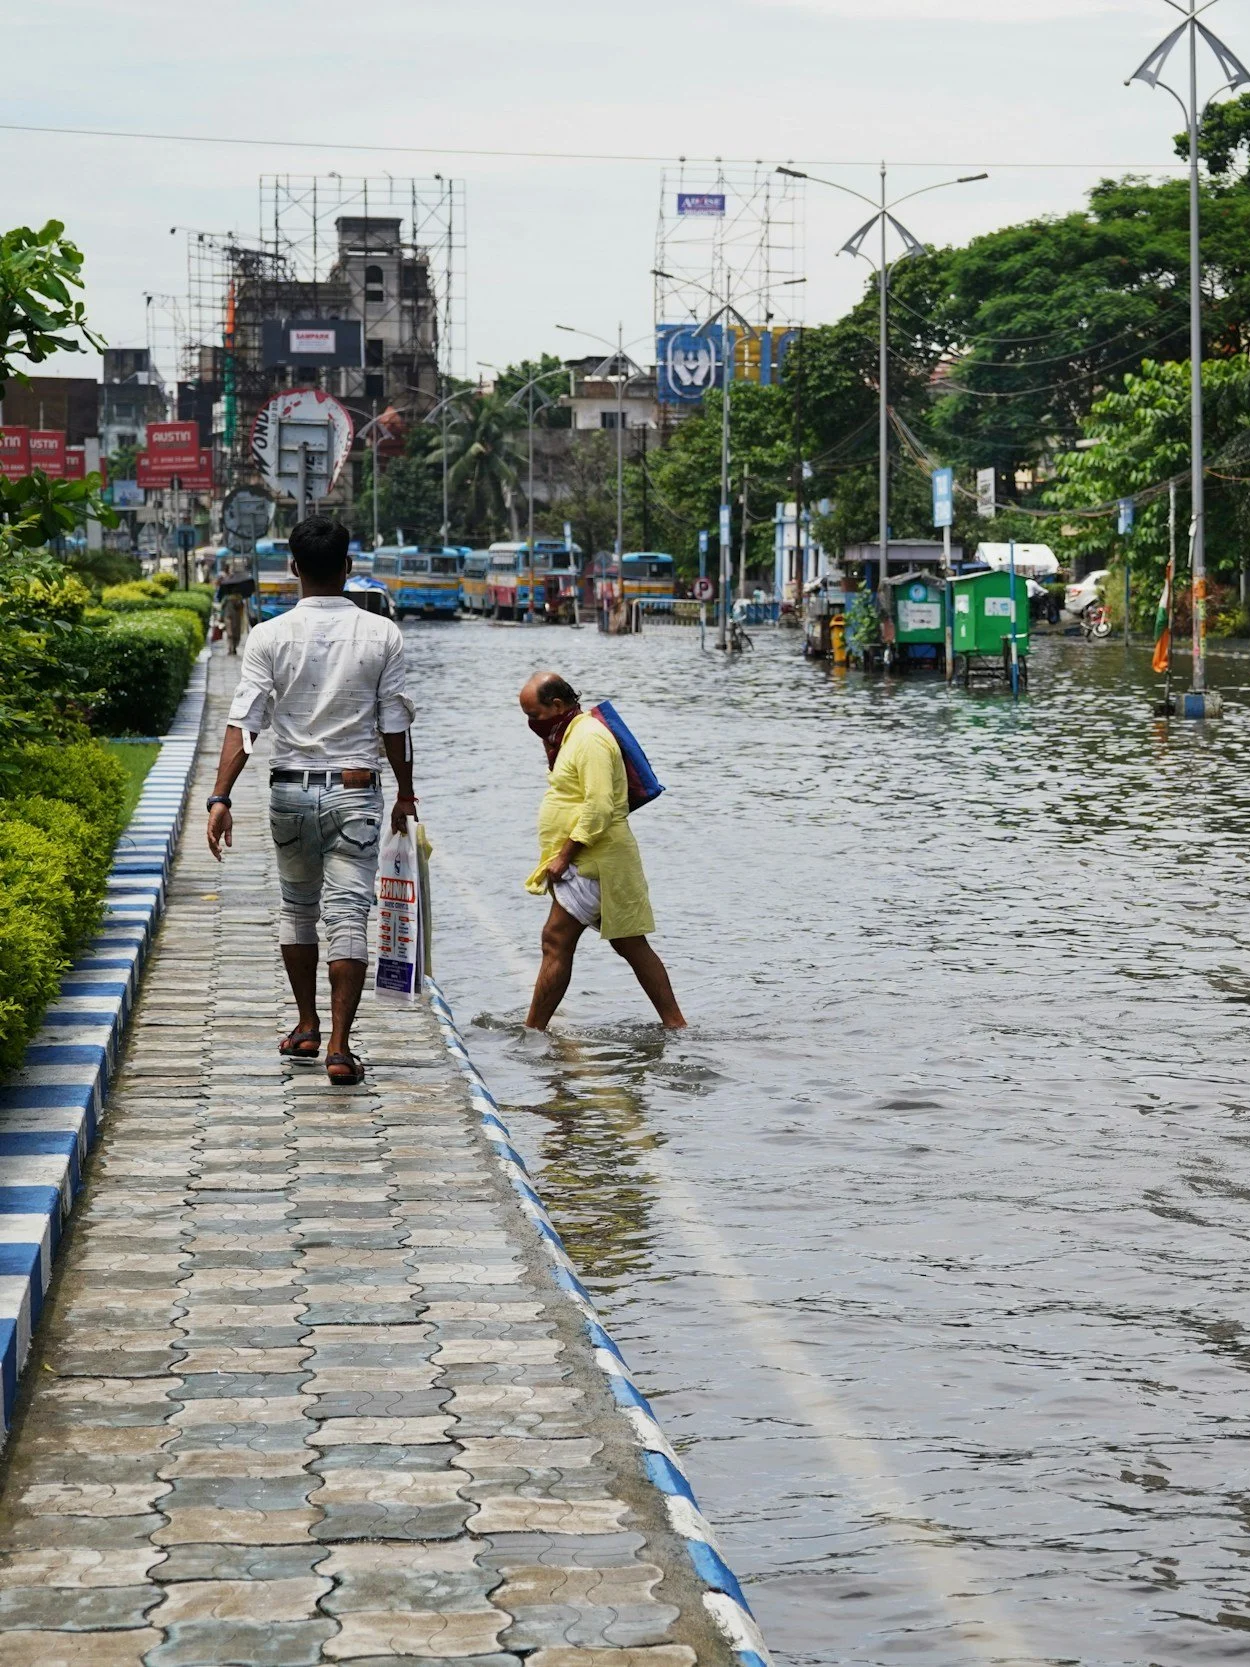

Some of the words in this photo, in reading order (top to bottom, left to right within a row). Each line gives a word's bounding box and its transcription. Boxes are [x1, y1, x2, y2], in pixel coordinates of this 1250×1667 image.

[152, 431, 191, 442] AUSTIN
[30, 439, 58, 449] USTIN
[699, 581, 709, 597] P
